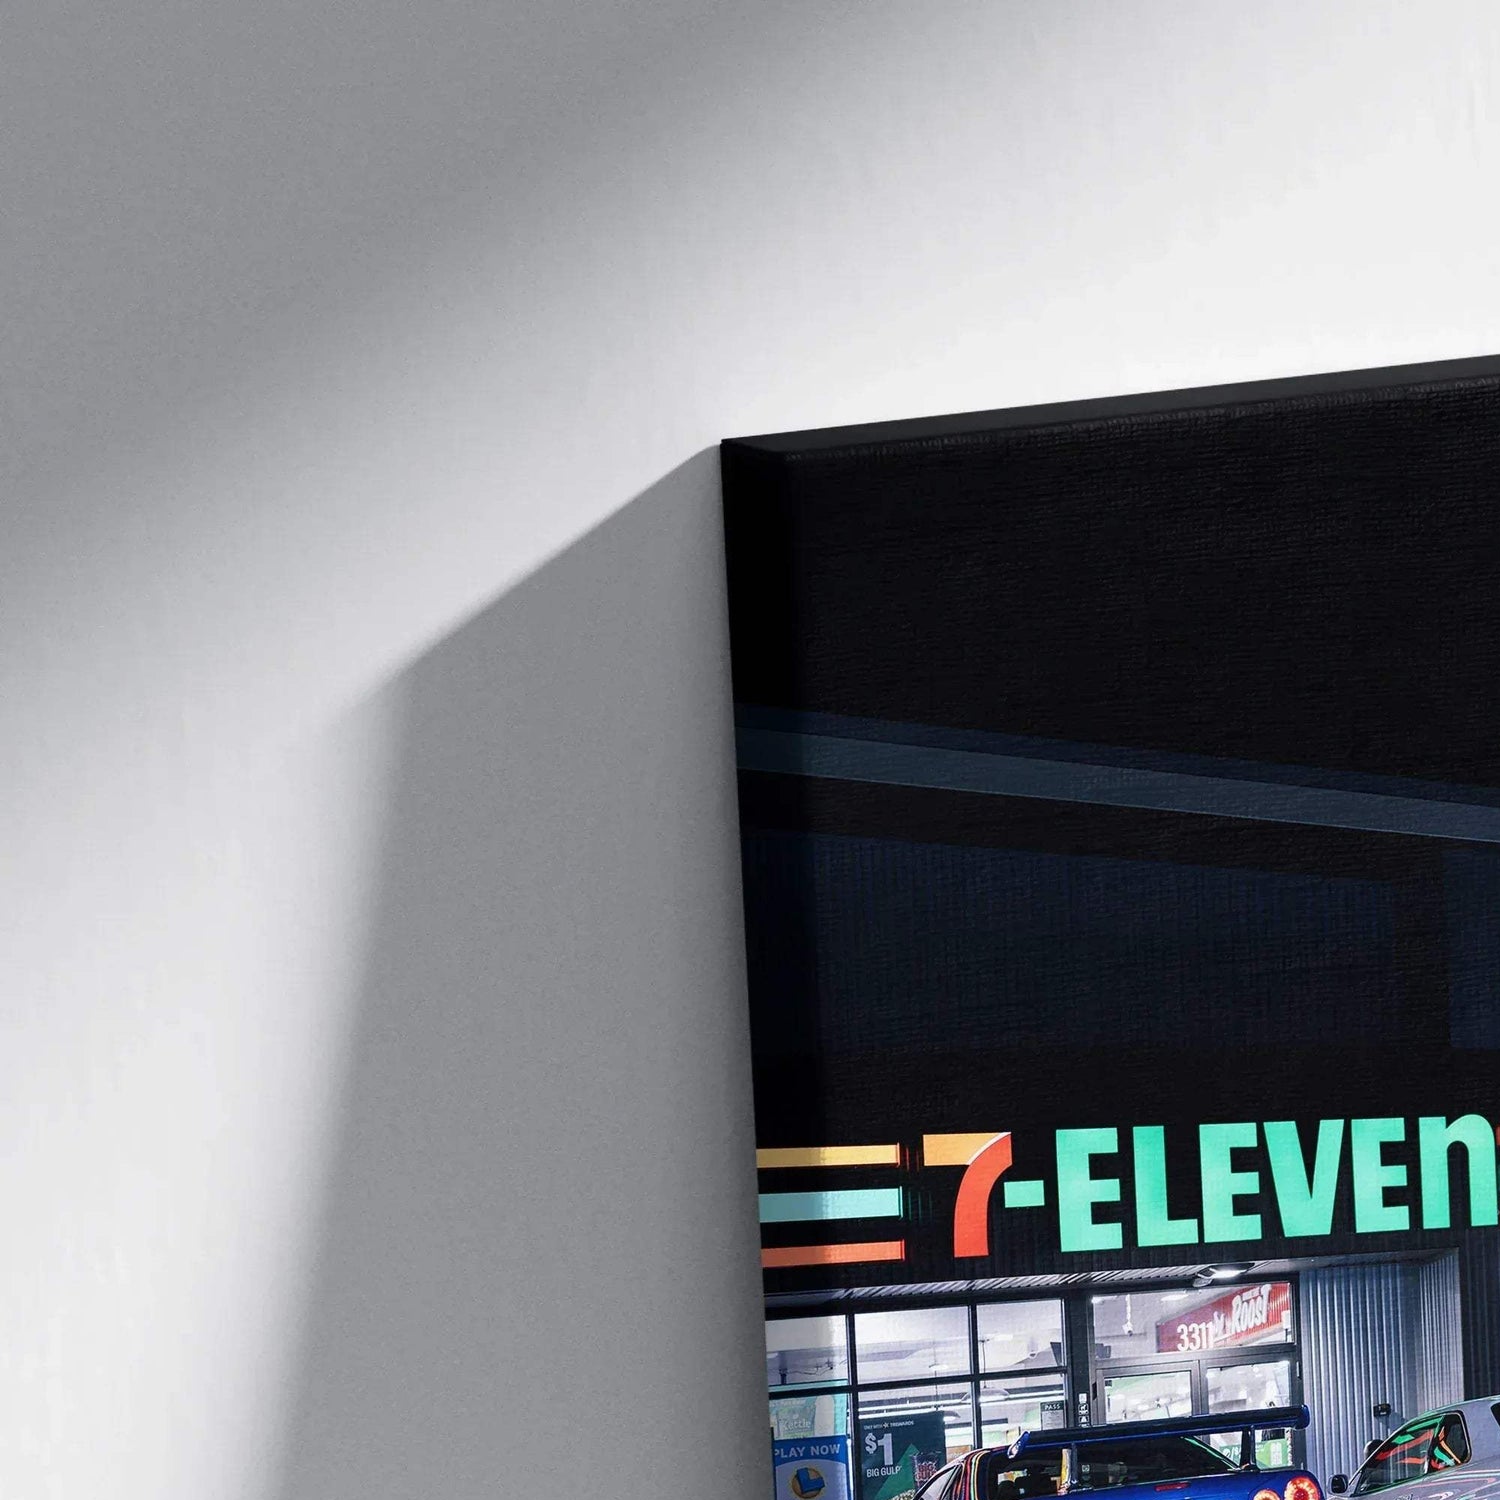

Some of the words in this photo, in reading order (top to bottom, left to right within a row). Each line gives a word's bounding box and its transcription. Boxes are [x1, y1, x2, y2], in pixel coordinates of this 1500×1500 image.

[810, 1444, 840, 1456] NOW
[866, 1468, 879, 1478] BIG
[880, 1465, 900, 1476] GULP
